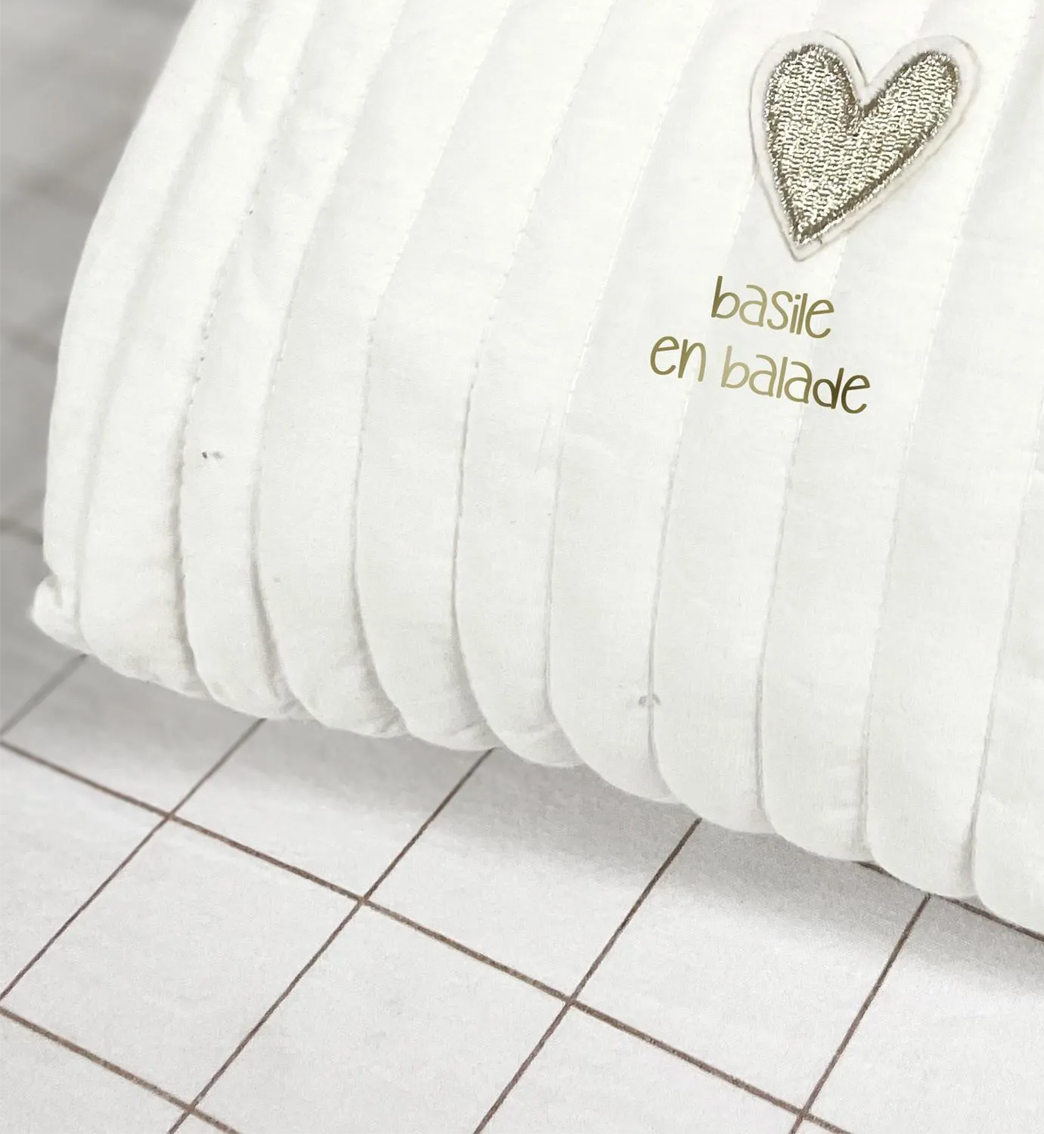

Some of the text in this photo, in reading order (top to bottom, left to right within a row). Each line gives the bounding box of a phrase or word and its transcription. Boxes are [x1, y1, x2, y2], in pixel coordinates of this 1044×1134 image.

[710, 275, 835, 339] basile
[650, 335, 871, 415] en balade
